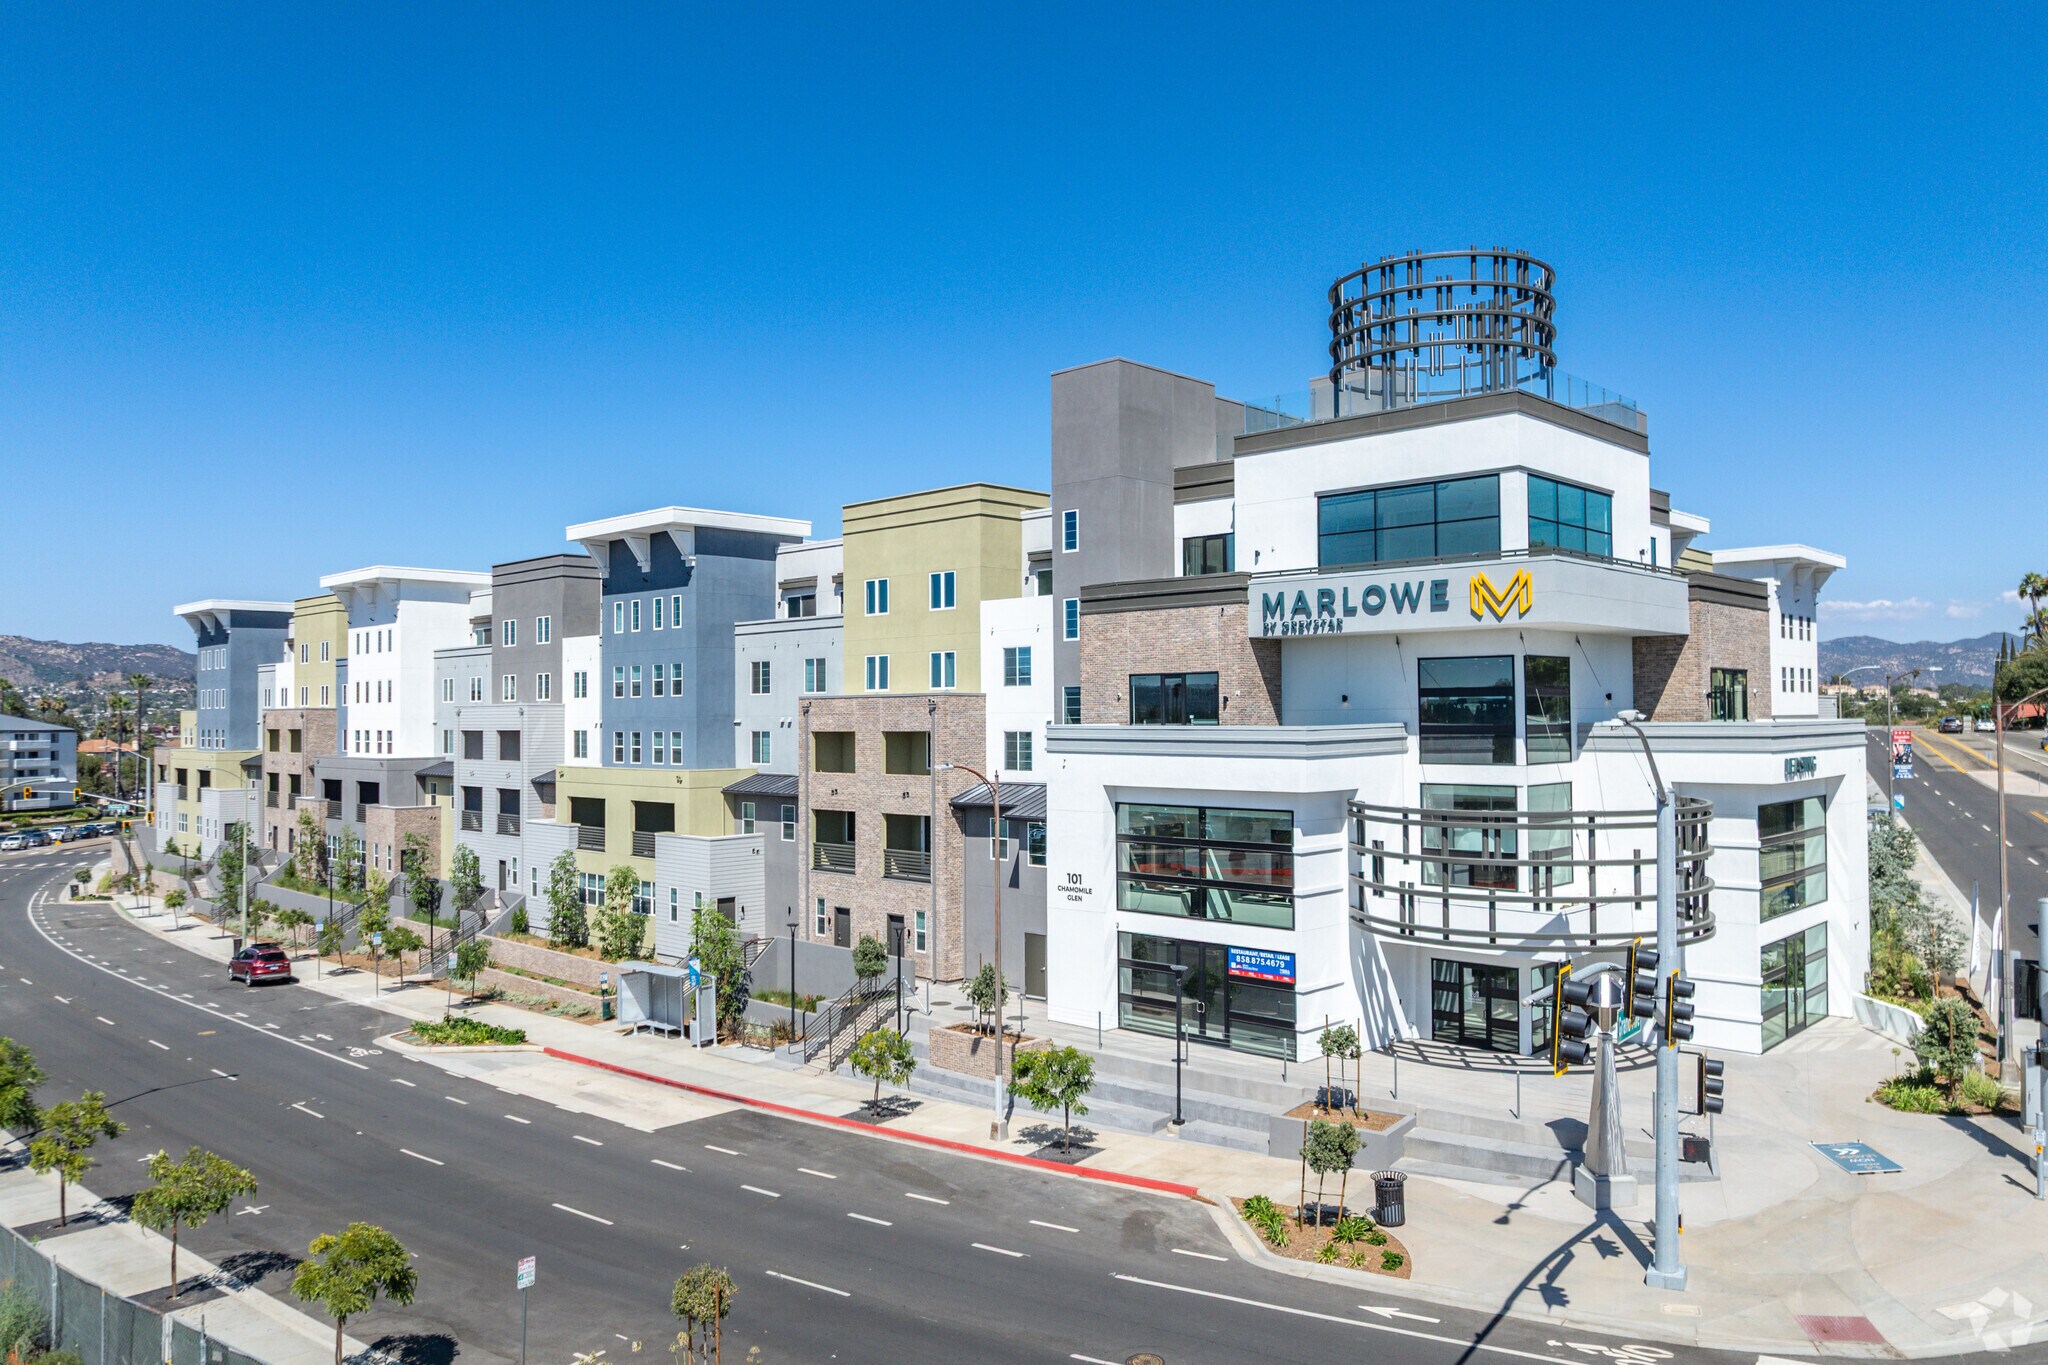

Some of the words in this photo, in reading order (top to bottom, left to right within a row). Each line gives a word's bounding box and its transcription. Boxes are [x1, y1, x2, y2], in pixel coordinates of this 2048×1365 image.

[1262, 578, 1450, 621] MARLOWE
[1262, 622, 1277, 636] BY
[1281, 618, 1343, 636] GREYSTAR
[1067, 873, 1082, 885] 101
[1057, 885, 1092, 894] CHAMOMILE
